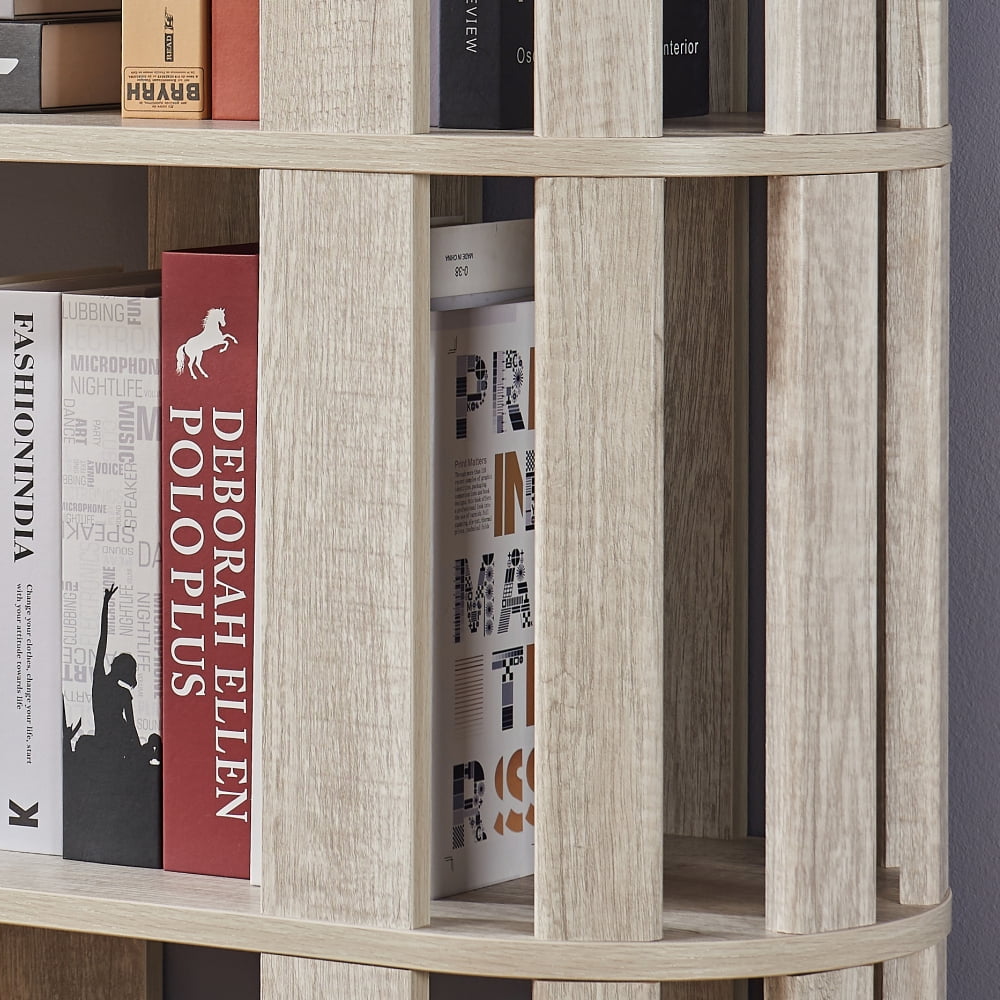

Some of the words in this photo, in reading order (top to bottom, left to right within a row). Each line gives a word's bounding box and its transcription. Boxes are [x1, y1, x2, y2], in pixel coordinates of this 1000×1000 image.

[663, 39, 698, 56] nterior
[127, 83, 200, 100] BRYRH
[445, 253, 458, 262] CHINA
[463, 252, 474, 260] MADE
[70, 354, 160, 375] MICROPHON
[70, 376, 143, 398] NIGHTLIFE
[13, 311, 35, 562] FASHIONINDIA
[63, 399, 75, 445] DANCE
[75, 418, 87, 446] ART
[92, 420, 102, 447] PARTY
[119, 401, 135, 463] MUSIC
[95, 462, 124, 476] VOICE
[170, 405, 204, 556] POLO
[124, 463, 137, 529] SPEAKER
[62, 523, 135, 544] SPEAK
[213, 407, 246, 647] DEBORAH
[103, 546, 134, 556] SOUND
[139, 541, 160, 568] DA
[25, 584, 33, 615] Change
[119, 585, 134, 636] NIGHTLIFE
[64, 593, 77, 645] CLUBBING
[137, 592, 150, 672] NIGHTLIFE
[171, 568, 206, 696] PLUS
[25, 673, 33, 703] change
[137, 718, 160, 730] SOUN
[214, 665, 248, 822] ELLEN
[8, 799, 39, 828] K
